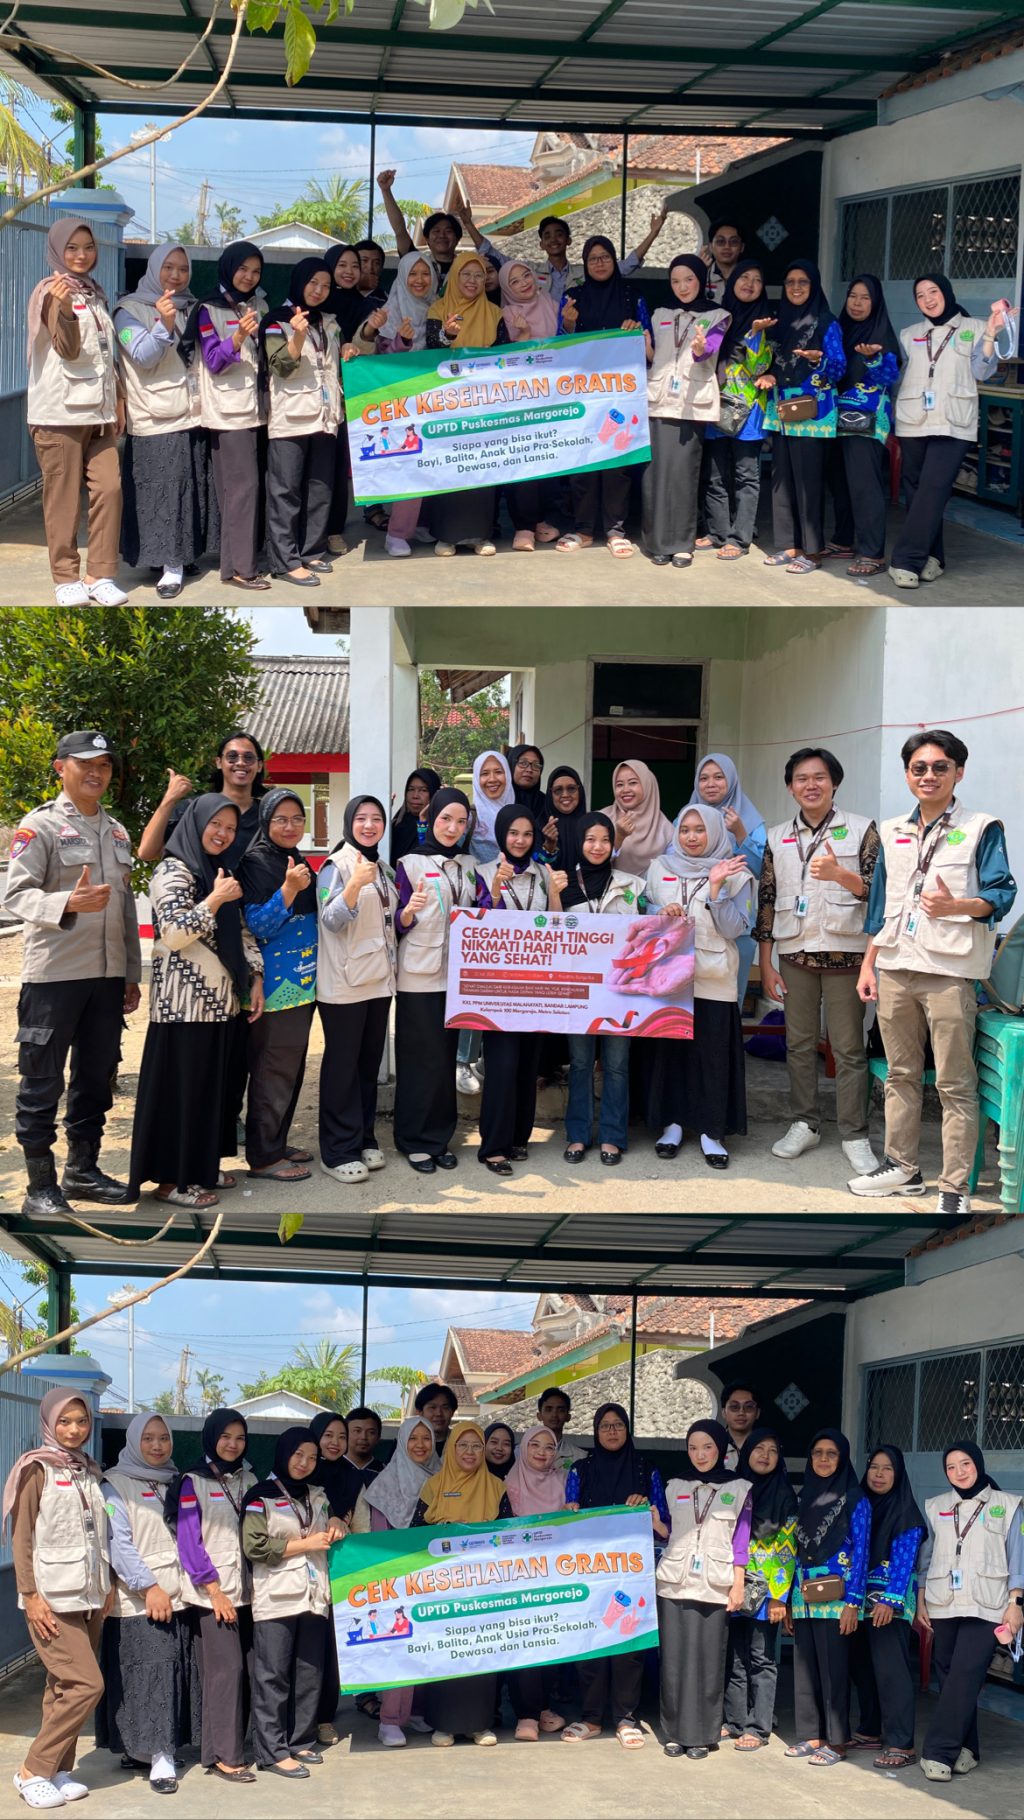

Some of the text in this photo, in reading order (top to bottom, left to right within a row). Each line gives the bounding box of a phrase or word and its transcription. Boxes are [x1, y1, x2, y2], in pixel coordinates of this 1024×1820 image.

[361, 372, 637, 425] CEK KESEHATAN GRATIS
[427, 406, 580, 434] UPTD Puskesmas Margorejo
[417, 437, 593, 468] Bayi, Balita, Anak Usia Pra-Sekolah,
[452, 429, 558, 452] Siapa yang bisa ikut?
[457, 452, 559, 473] Dewasa, dan Lansia.
[461, 926, 615, 944] CEGAH DARAH TINGGI
[461, 939, 588, 956] NIKMATI HARI TUA
[461, 952, 552, 966] YANG SEHAT!
[347, 1552, 644, 1607] CEK KESEHATAN GRATIS
[417, 1588, 583, 1617] UPTD Puskesmas Margorejo
[445, 1612, 559, 1636] Siapa yang bisa ikut?
[407, 1620, 598, 1653] Bayi, Balita, Anak Usia Pra-Sekolah,
[450, 1637, 560, 1659] Dewasa, dan Lansia.
